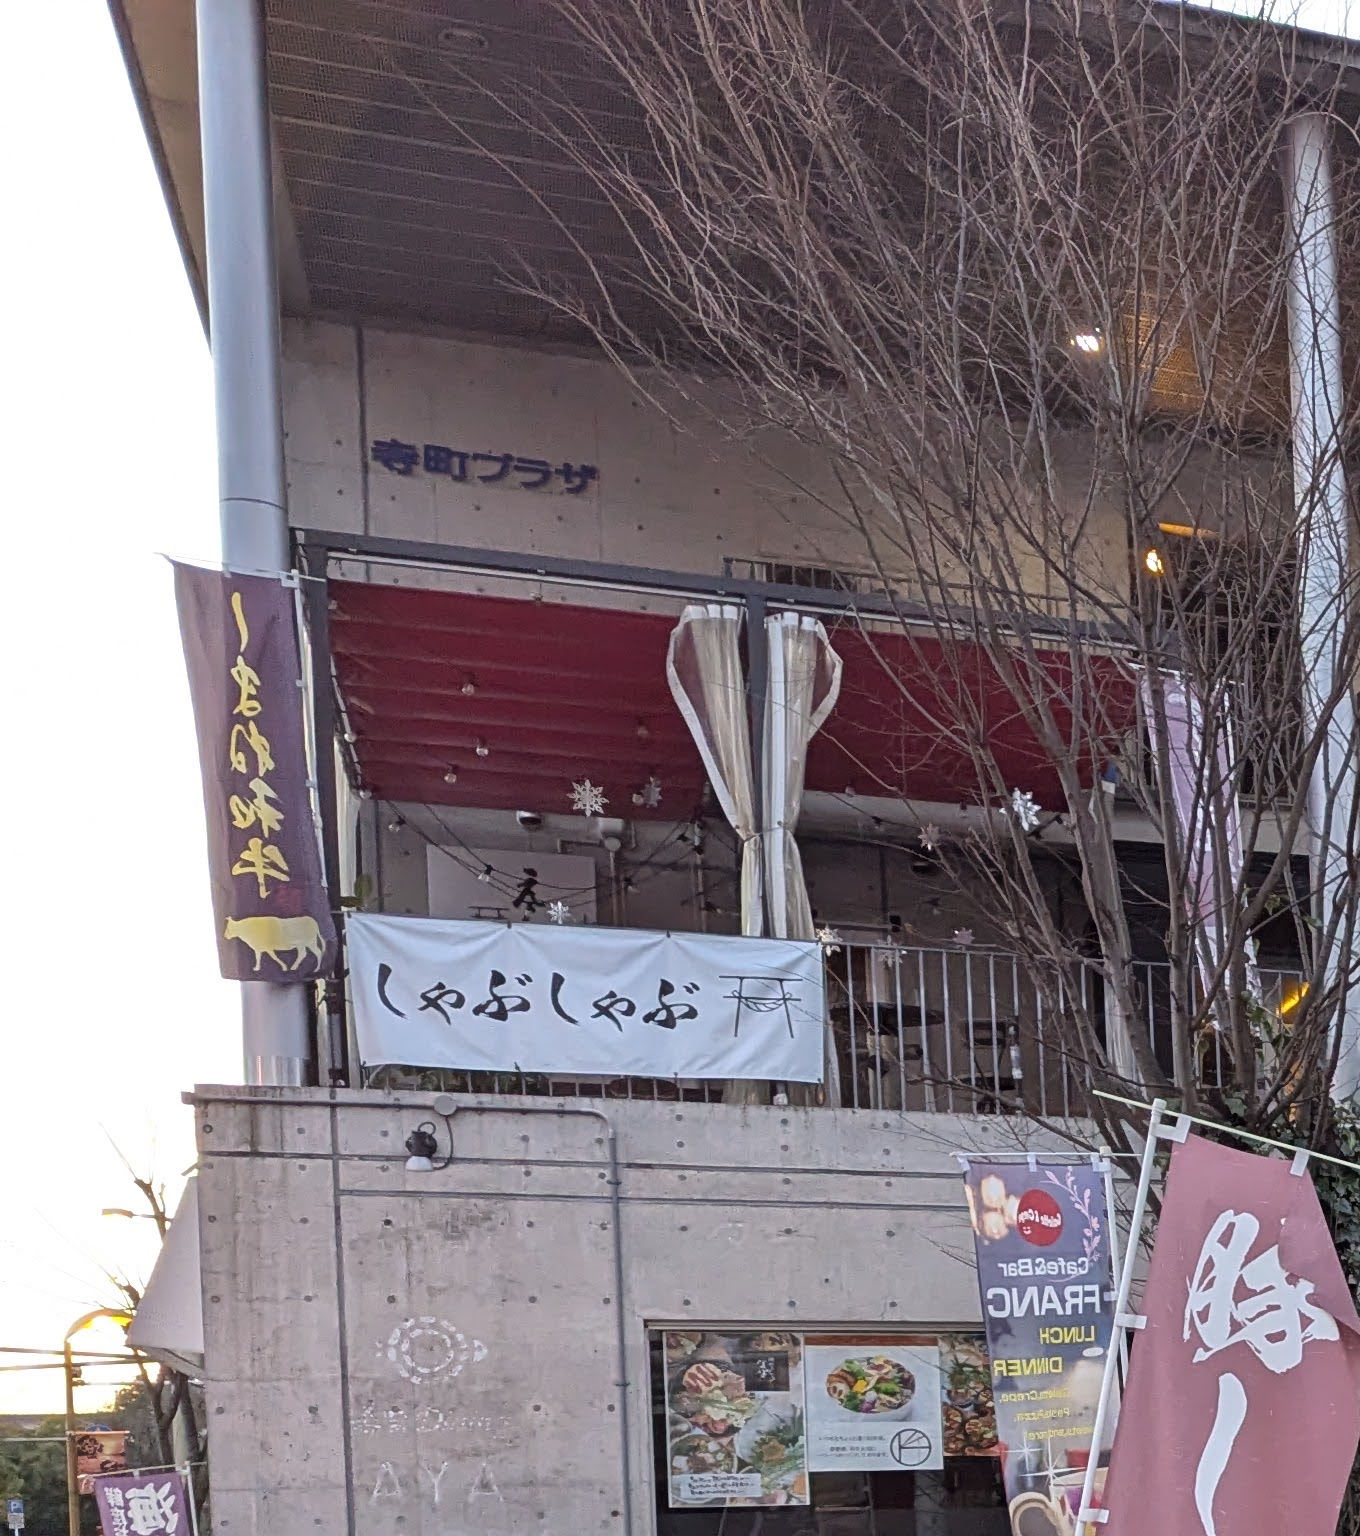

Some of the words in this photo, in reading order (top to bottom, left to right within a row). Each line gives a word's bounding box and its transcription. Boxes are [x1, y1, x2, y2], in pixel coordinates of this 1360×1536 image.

[371, 438, 597, 494] 寺町プラザ
[377, 962, 699, 1033] しゃぶしゃぶ
